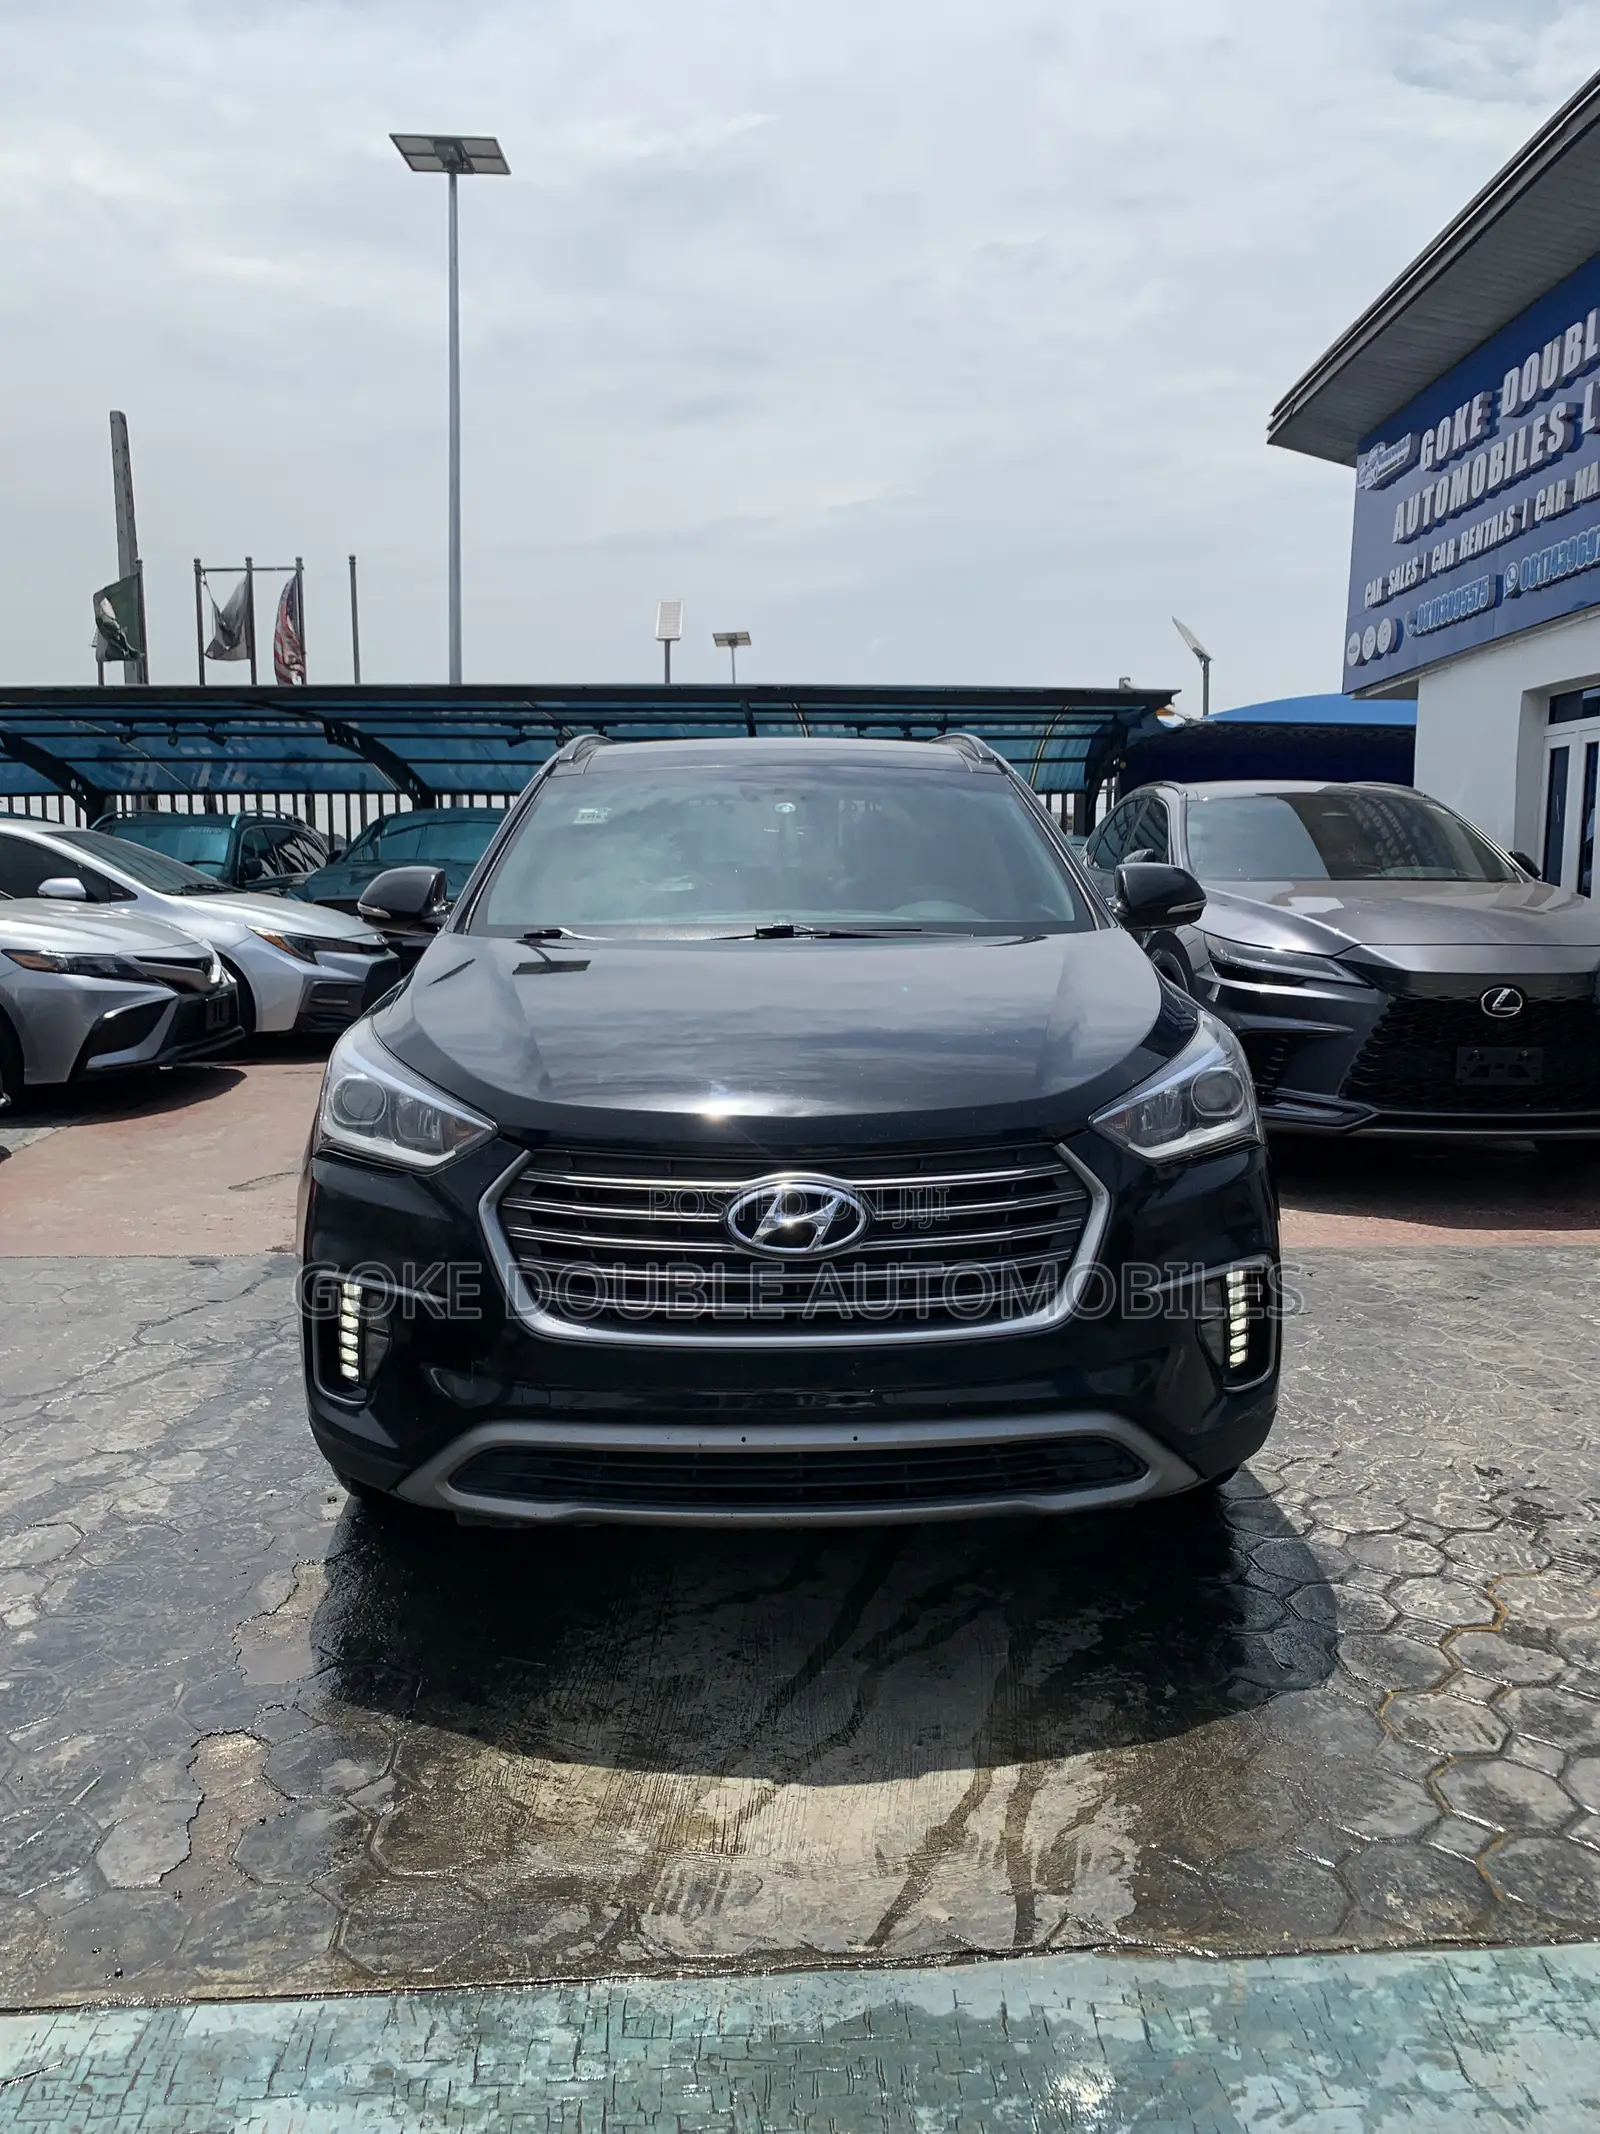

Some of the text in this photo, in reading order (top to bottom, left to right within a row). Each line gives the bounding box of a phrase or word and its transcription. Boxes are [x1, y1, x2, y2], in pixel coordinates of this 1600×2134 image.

[1420, 307, 1599, 472] GOKE DOUBL
[1365, 576, 1383, 608] CAR
[1388, 556, 1418, 596] SALES
[1431, 538, 1456, 574] CAR
[1459, 505, 1515, 561] RENTALS
[1534, 478, 1568, 522] CAR
[1573, 460, 1599, 503] MA
[1393, 401, 1567, 543] AUTOMOBILES
